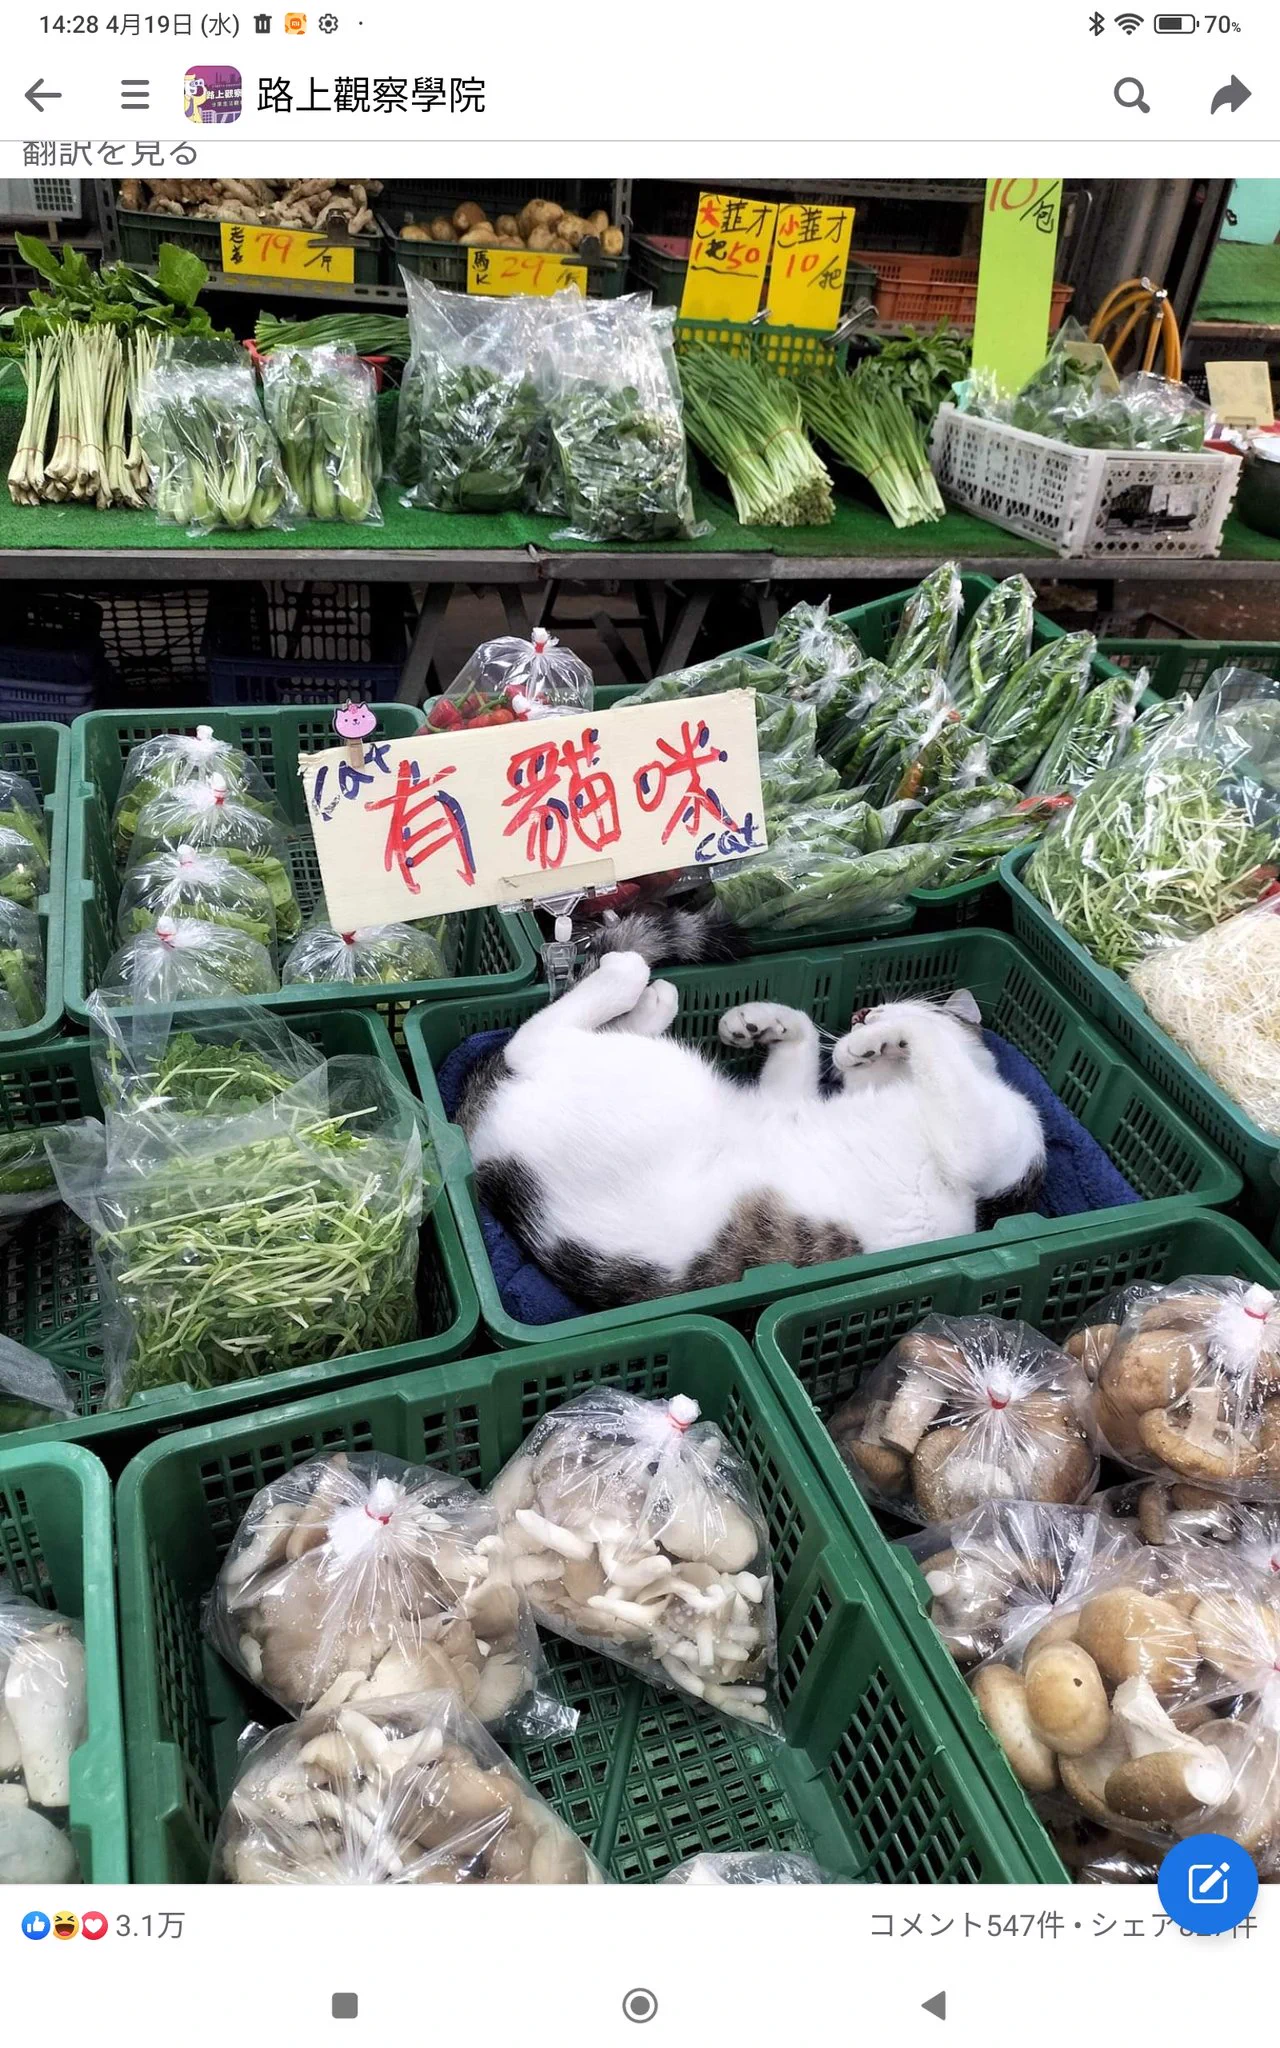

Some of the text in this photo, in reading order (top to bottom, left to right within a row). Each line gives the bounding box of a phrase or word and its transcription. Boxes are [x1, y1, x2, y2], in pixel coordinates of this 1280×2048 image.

[40, 13, 240, 38] 14:28 4月19日 (水)
[1205, 15, 1242, 34] 70%
[257, 76, 486, 114] 路上觀察學院
[23, 141, 197, 167] 翻訳を見る
[695, 812, 766, 862] cat
[116, 1912, 185, 1939] 3.1万
[871, 1910, 1065, 1939] コメント547件
